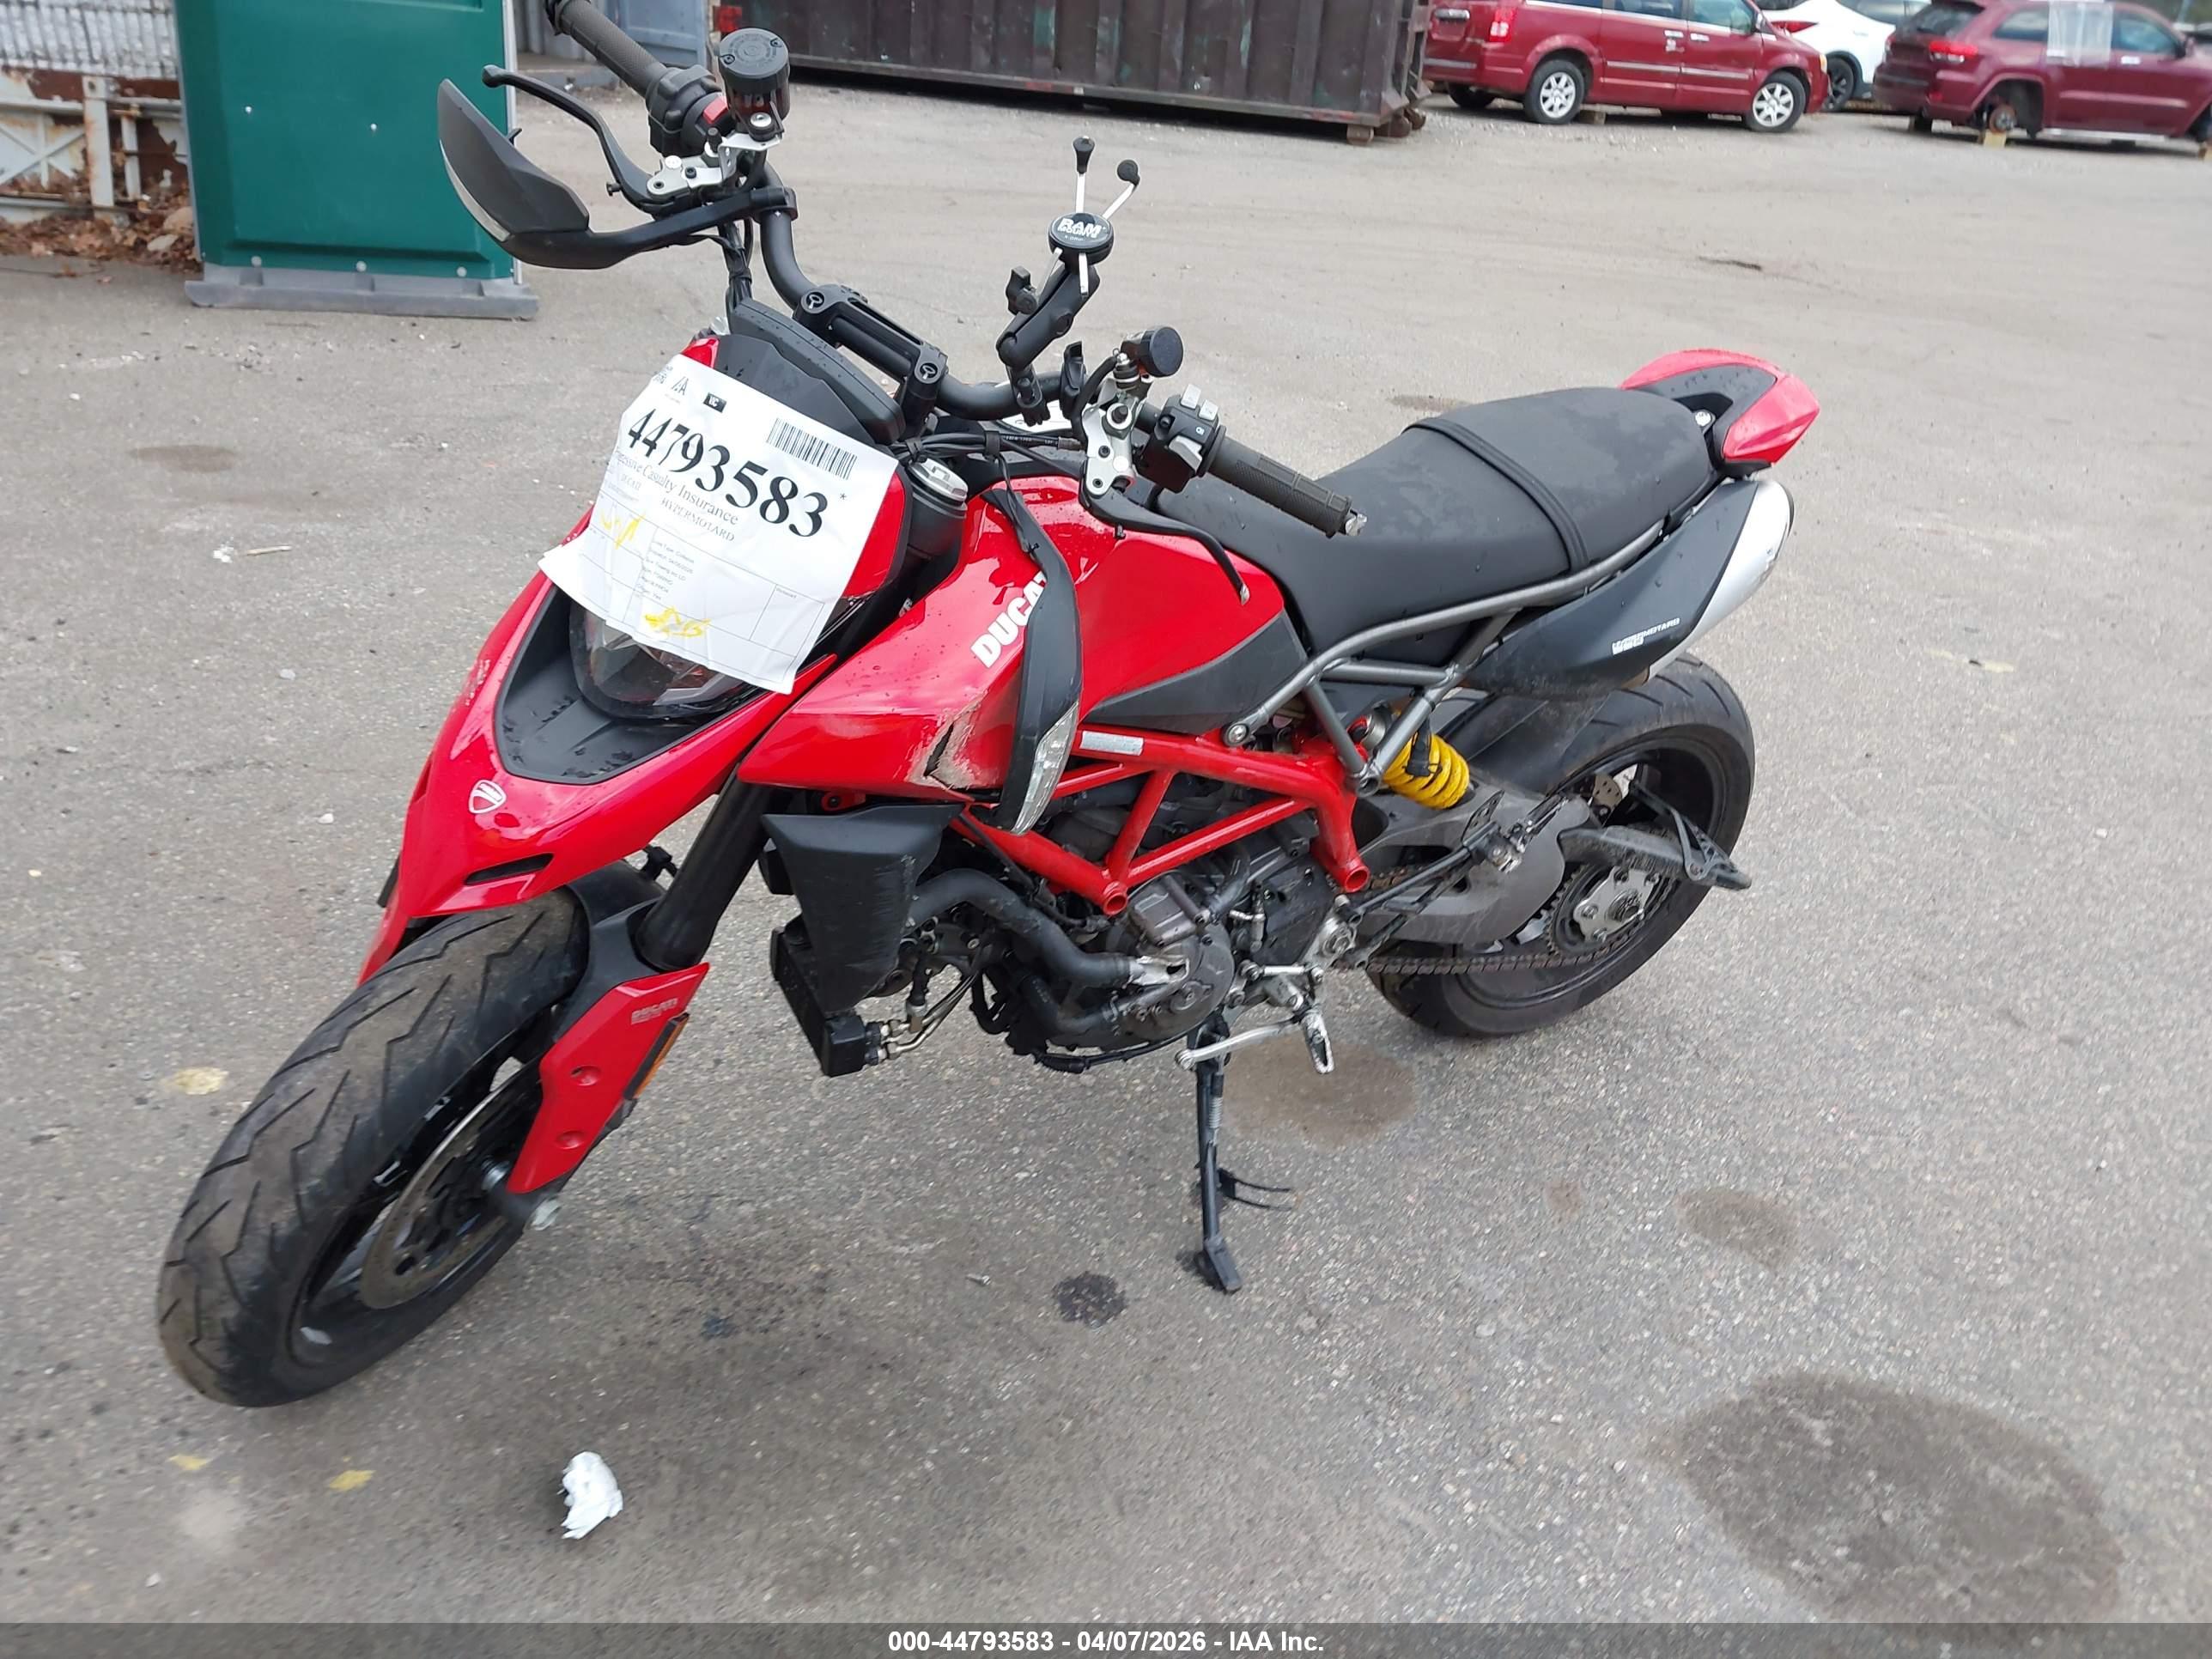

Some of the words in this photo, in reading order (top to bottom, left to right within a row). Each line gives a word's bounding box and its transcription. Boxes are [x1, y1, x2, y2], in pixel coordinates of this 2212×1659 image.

[628, 408, 829, 538] 44793583
[678, 484, 738, 526] Insurance
[660, 496, 736, 542] HYPERMOTARD
[970, 571, 1047, 668] DUCA
